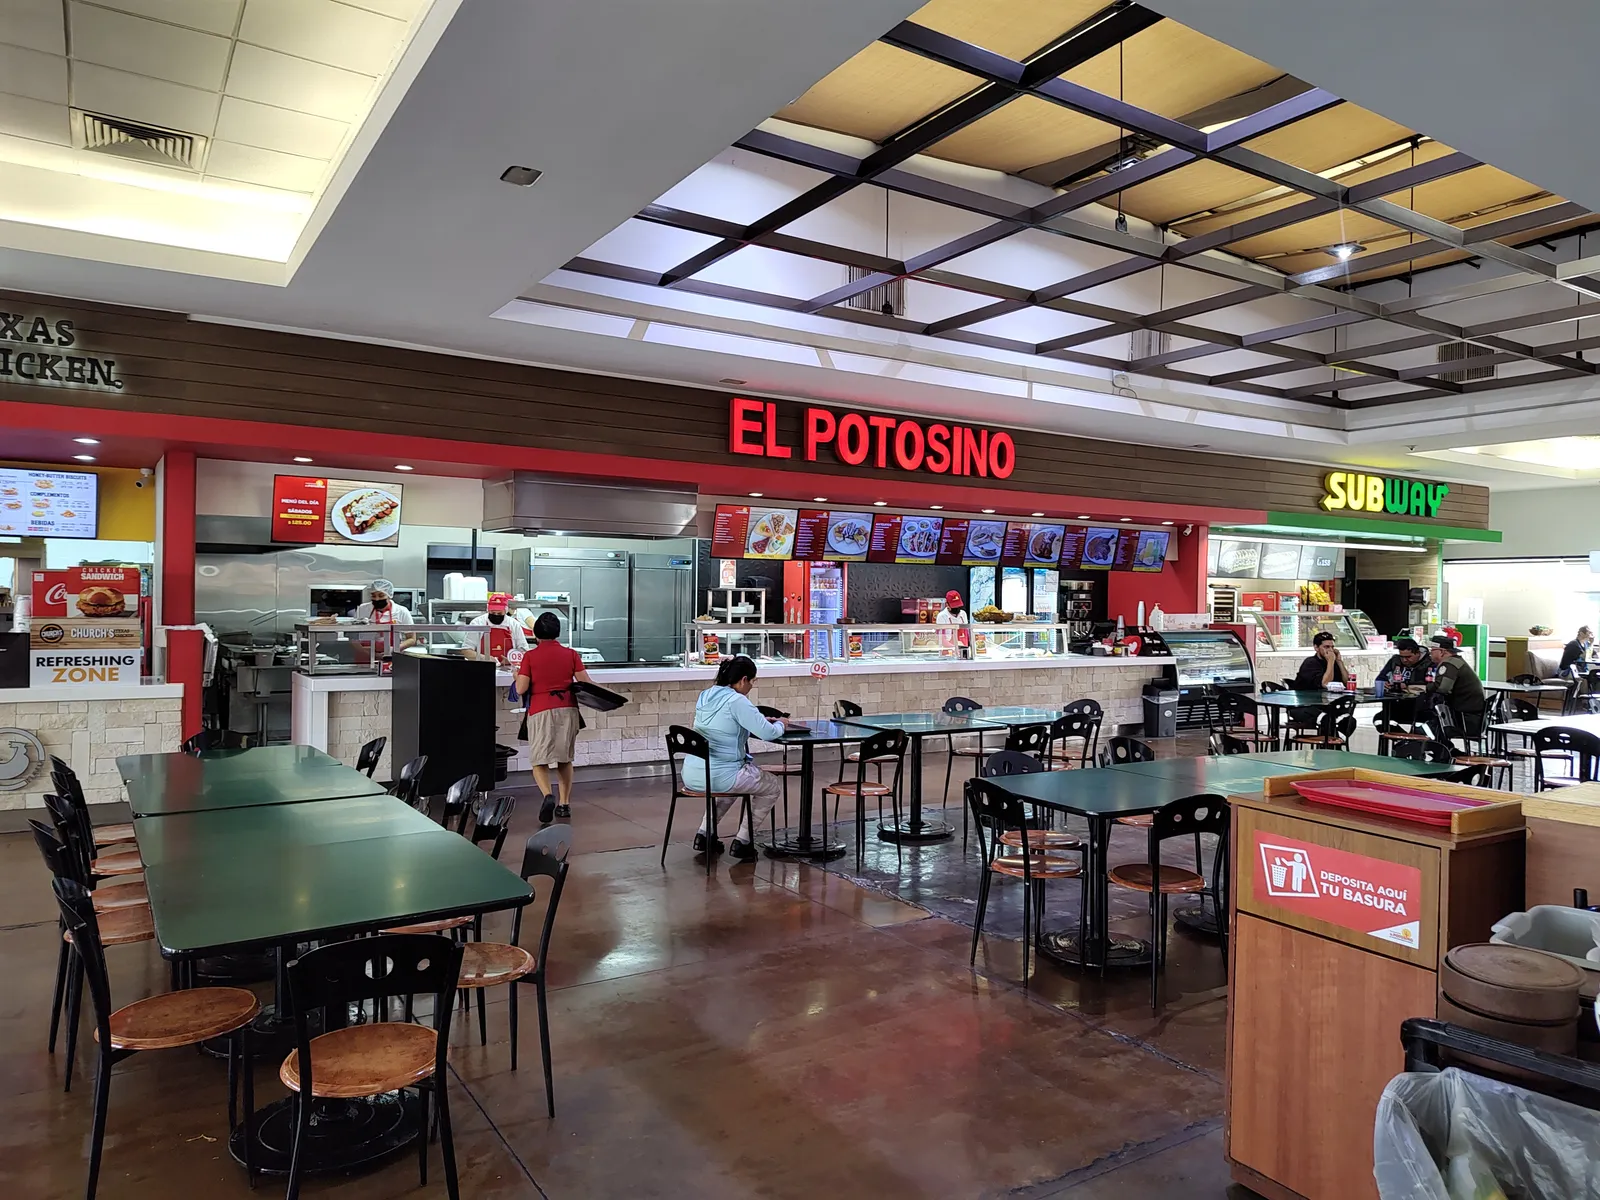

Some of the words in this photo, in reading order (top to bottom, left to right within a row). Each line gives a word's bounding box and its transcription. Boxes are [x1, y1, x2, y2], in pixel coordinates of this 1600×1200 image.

[730, 398, 792, 458] EL
[805, 407, 1016, 479] POTOSINO
[1321, 472, 1450, 517] SUBWAY
[80, 572, 125, 580] SANDWICH
[70, 628, 115, 638] CHURCH'S
[36, 655, 135, 667] REFRESHING
[813, 664, 827, 673] 06
[51, 667, 120, 683] ZONE
[1320, 870, 1375, 893] DEPOSITA
[1377, 885, 1408, 901] AQUÍ
[1320, 882, 1340, 897] TU
[1343, 888, 1408, 917] BASURA
